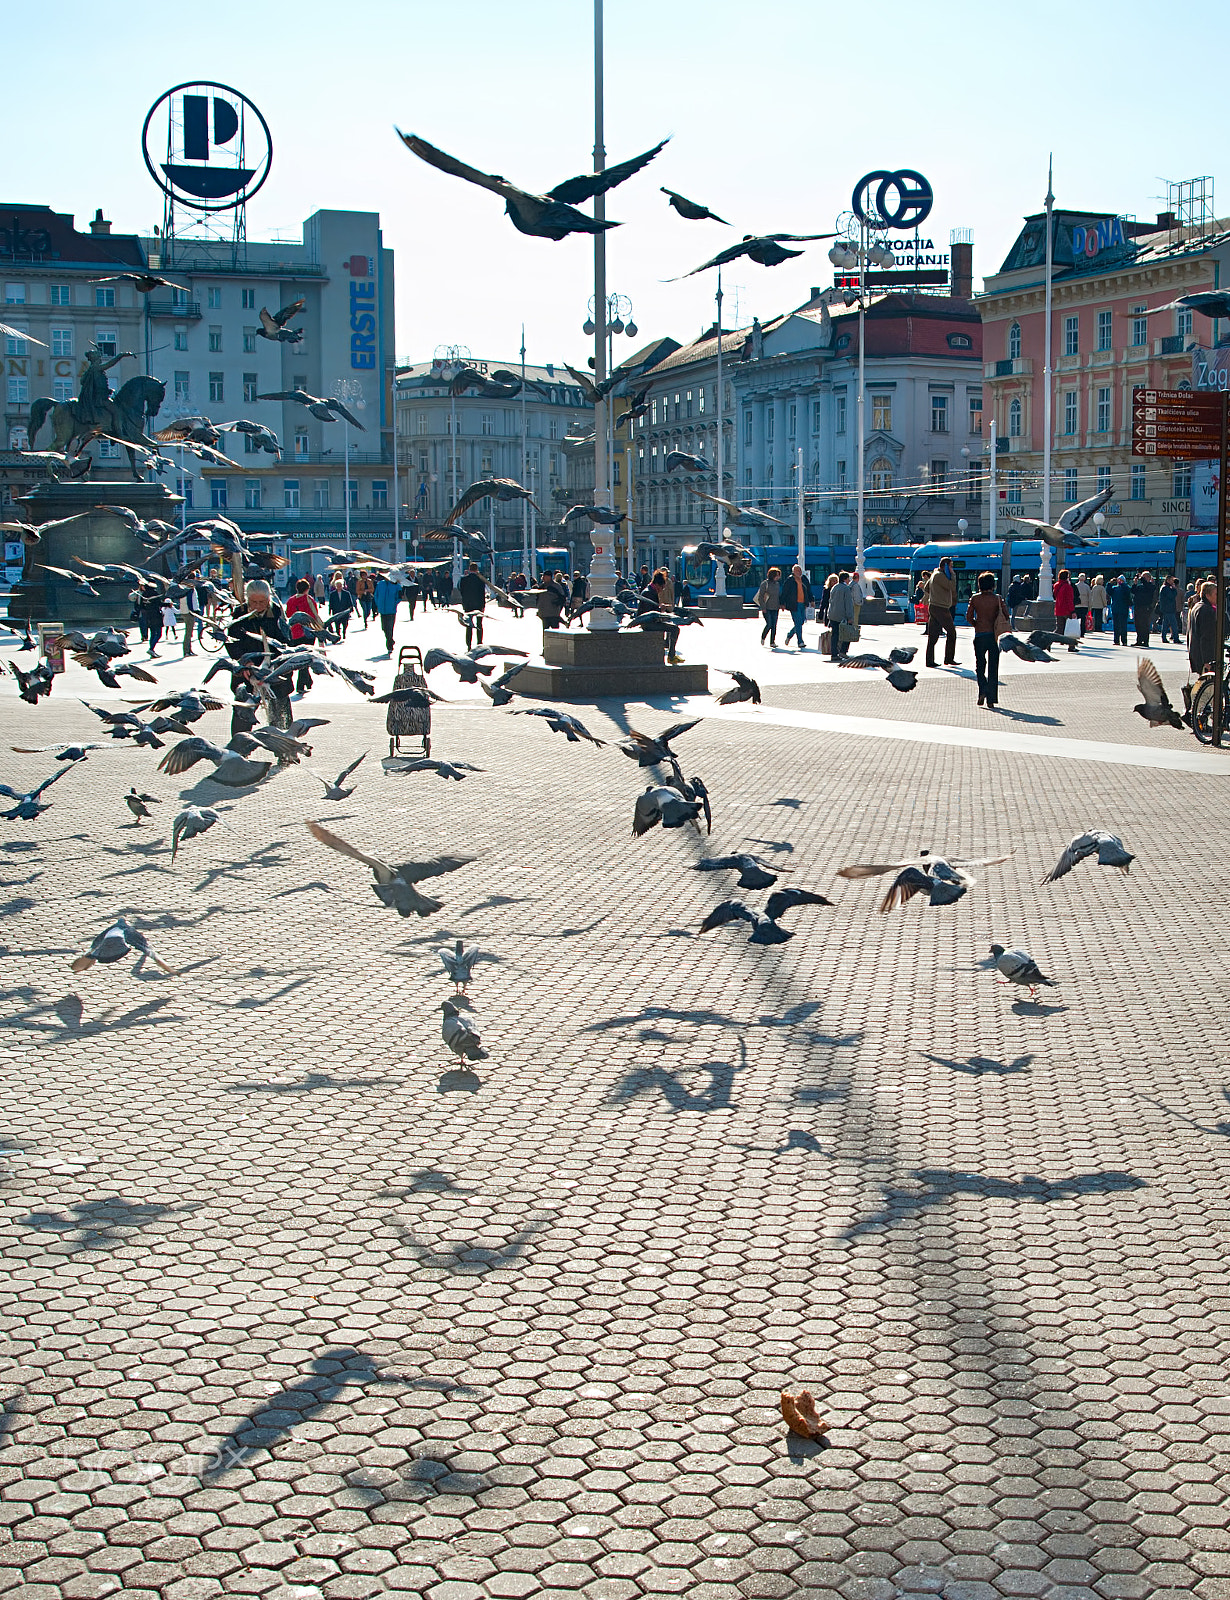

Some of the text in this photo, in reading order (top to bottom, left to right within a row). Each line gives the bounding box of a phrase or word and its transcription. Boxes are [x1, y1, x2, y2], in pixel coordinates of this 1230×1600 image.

[1072, 216, 1125, 257] DONA
[349, 281, 376, 370] ERSTE
[1202, 482, 1216, 498] vip
[998, 505, 1025, 516] SINGER
